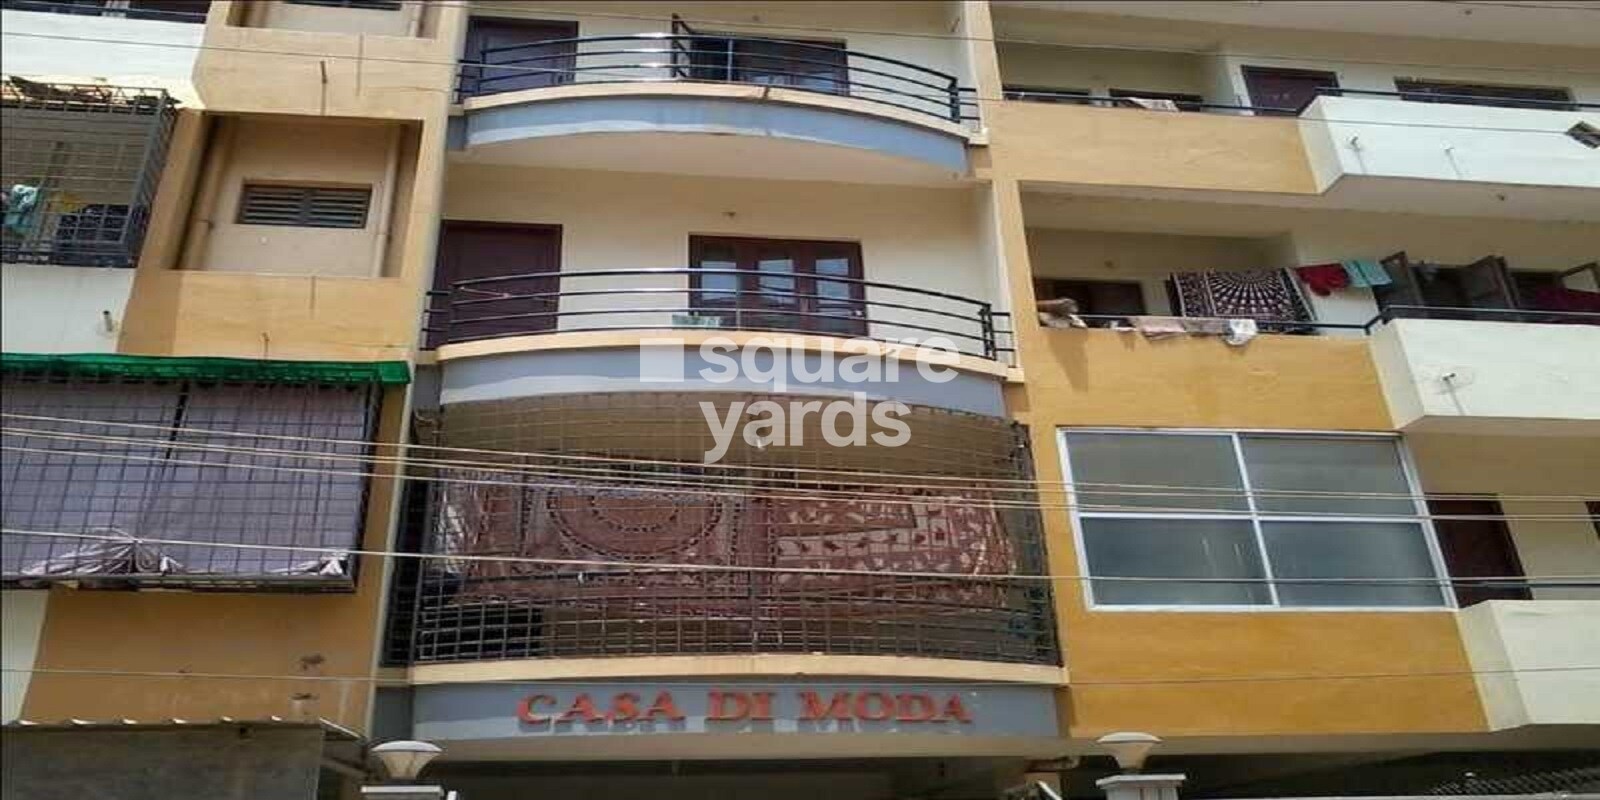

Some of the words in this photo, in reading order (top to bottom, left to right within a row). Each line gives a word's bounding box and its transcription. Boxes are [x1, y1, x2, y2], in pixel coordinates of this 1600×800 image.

[517, 691, 686, 724] CASA
[705, 687, 777, 721] DI
[796, 690, 973, 723] MODA
